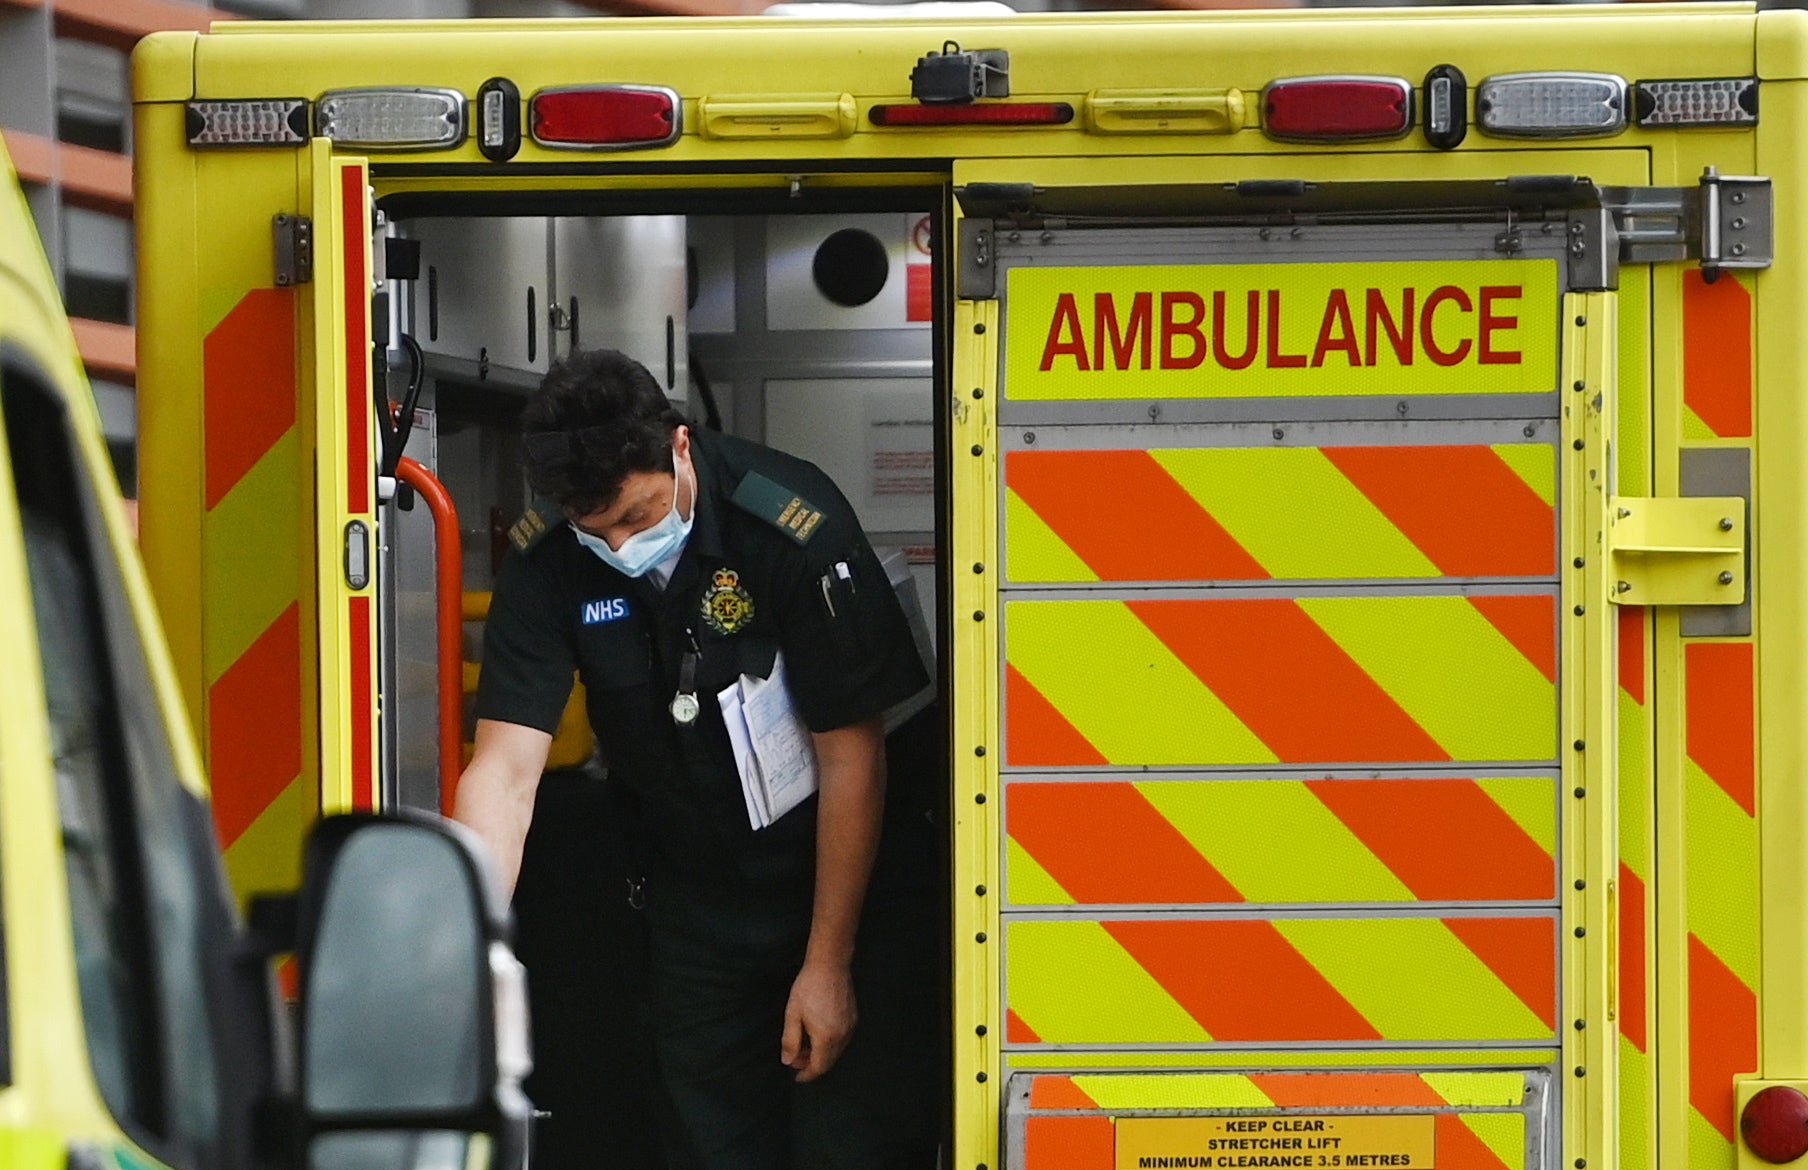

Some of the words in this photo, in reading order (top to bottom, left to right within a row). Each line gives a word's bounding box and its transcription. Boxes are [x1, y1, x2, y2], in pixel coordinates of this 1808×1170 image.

[1039, 285, 1523, 371] AMBULANCE
[586, 598, 625, 622] NHS
[1225, 1121, 1268, 1133] KEEP
[1272, 1120, 1325, 1132] CLEAR
[1208, 1138, 1303, 1150] STRETCHER
[1307, 1137, 1342, 1149] LIFT
[1138, 1156, 1213, 1168] MINIMUM
[1217, 1155, 1313, 1168] CLEARANCE
[1317, 1155, 1341, 1167] 3.5
[1345, 1154, 1411, 1166] METRES
